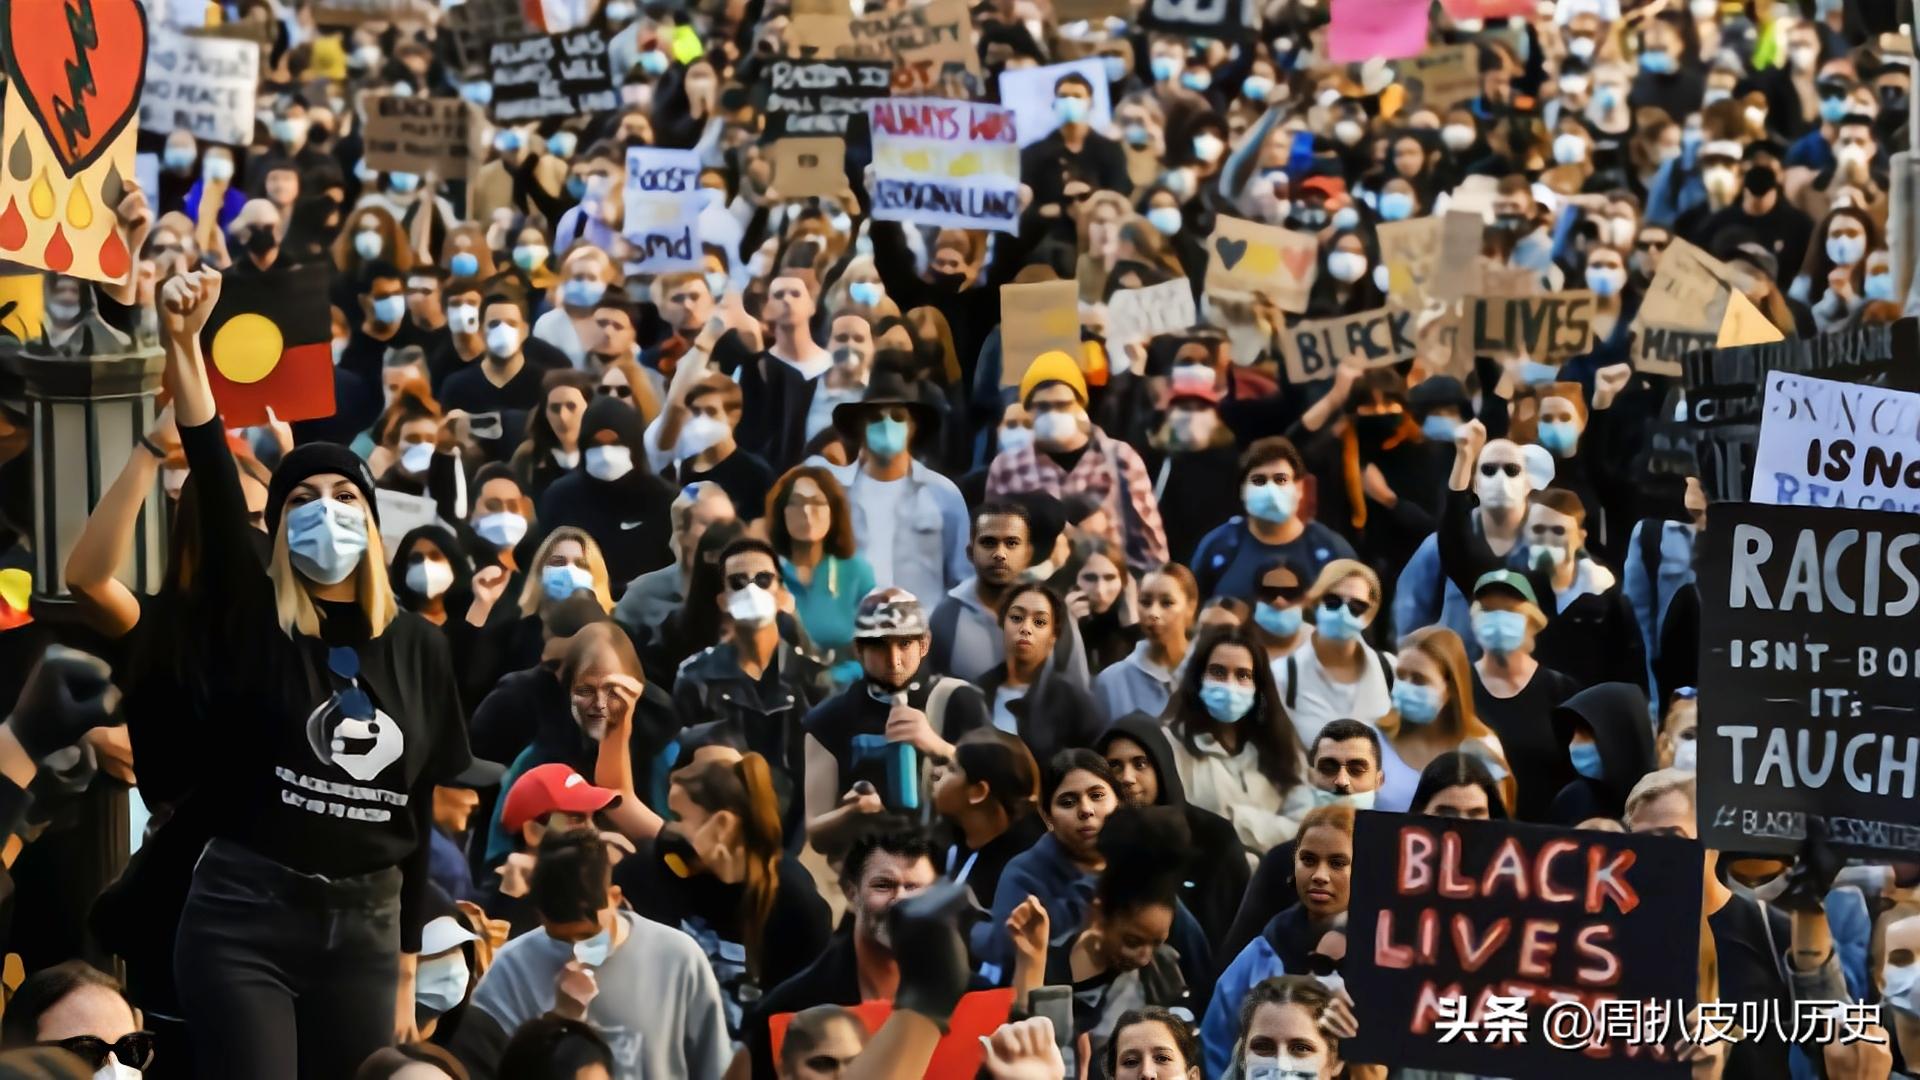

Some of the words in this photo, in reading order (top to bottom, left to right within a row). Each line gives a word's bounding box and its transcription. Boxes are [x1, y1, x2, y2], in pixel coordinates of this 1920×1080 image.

[872, 103, 960, 141] ALWAYS
[1296, 311, 1416, 374] BLACK
[1474, 299, 1591, 355] LIVES
[1807, 438, 1856, 482] IS
[1729, 524, 1920, 617] RACIS
[1717, 725, 1920, 799] TAUGH
[1398, 827, 1640, 914] BLACK
[1375, 907, 1622, 984] LIVES
